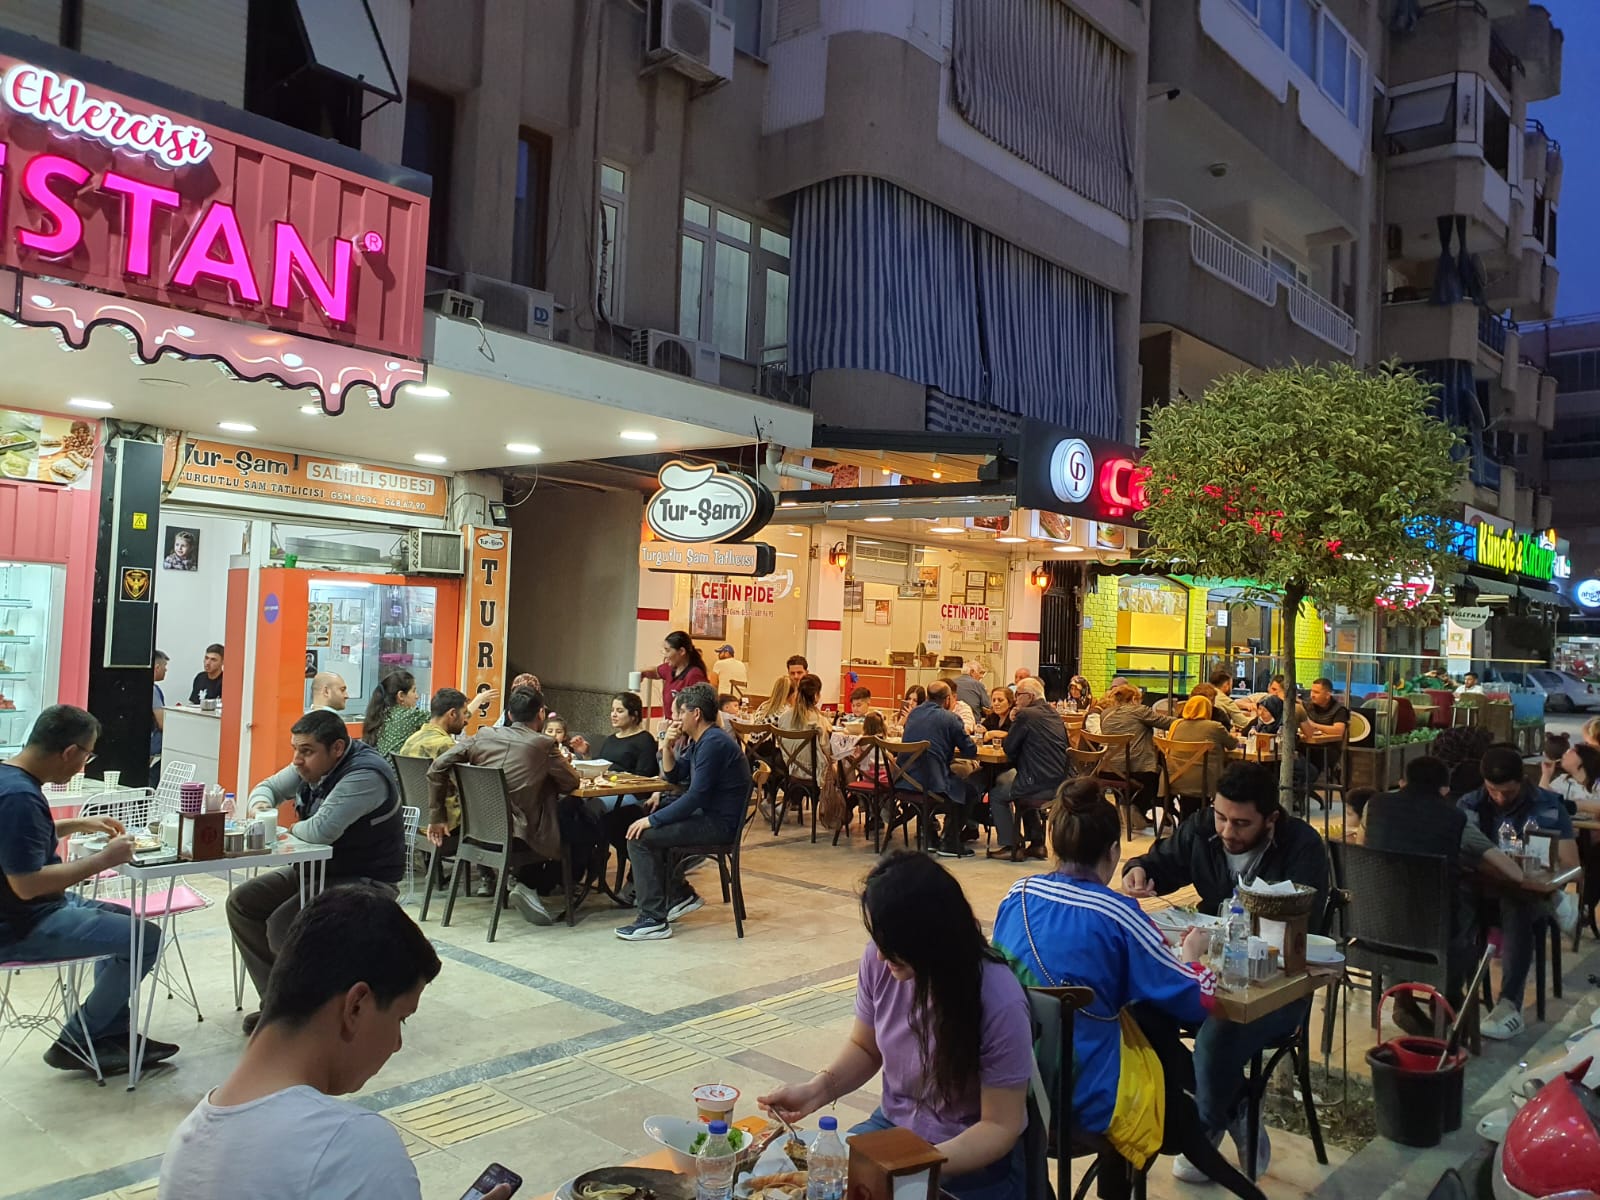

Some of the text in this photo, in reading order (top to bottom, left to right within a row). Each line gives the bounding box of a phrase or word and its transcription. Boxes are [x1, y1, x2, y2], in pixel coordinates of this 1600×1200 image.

[12, 69, 208, 161] Eklercisi
[0, 143, 353, 323] STAN
[180, 471, 240, 487] URGUTLU
[659, 498, 741, 526] Tur-Şam
[641, 547, 683, 566] Turgutlu
[1479, 521, 1516, 575] Künefe
[701, 579, 775, 603] ÇETİN PİDE
